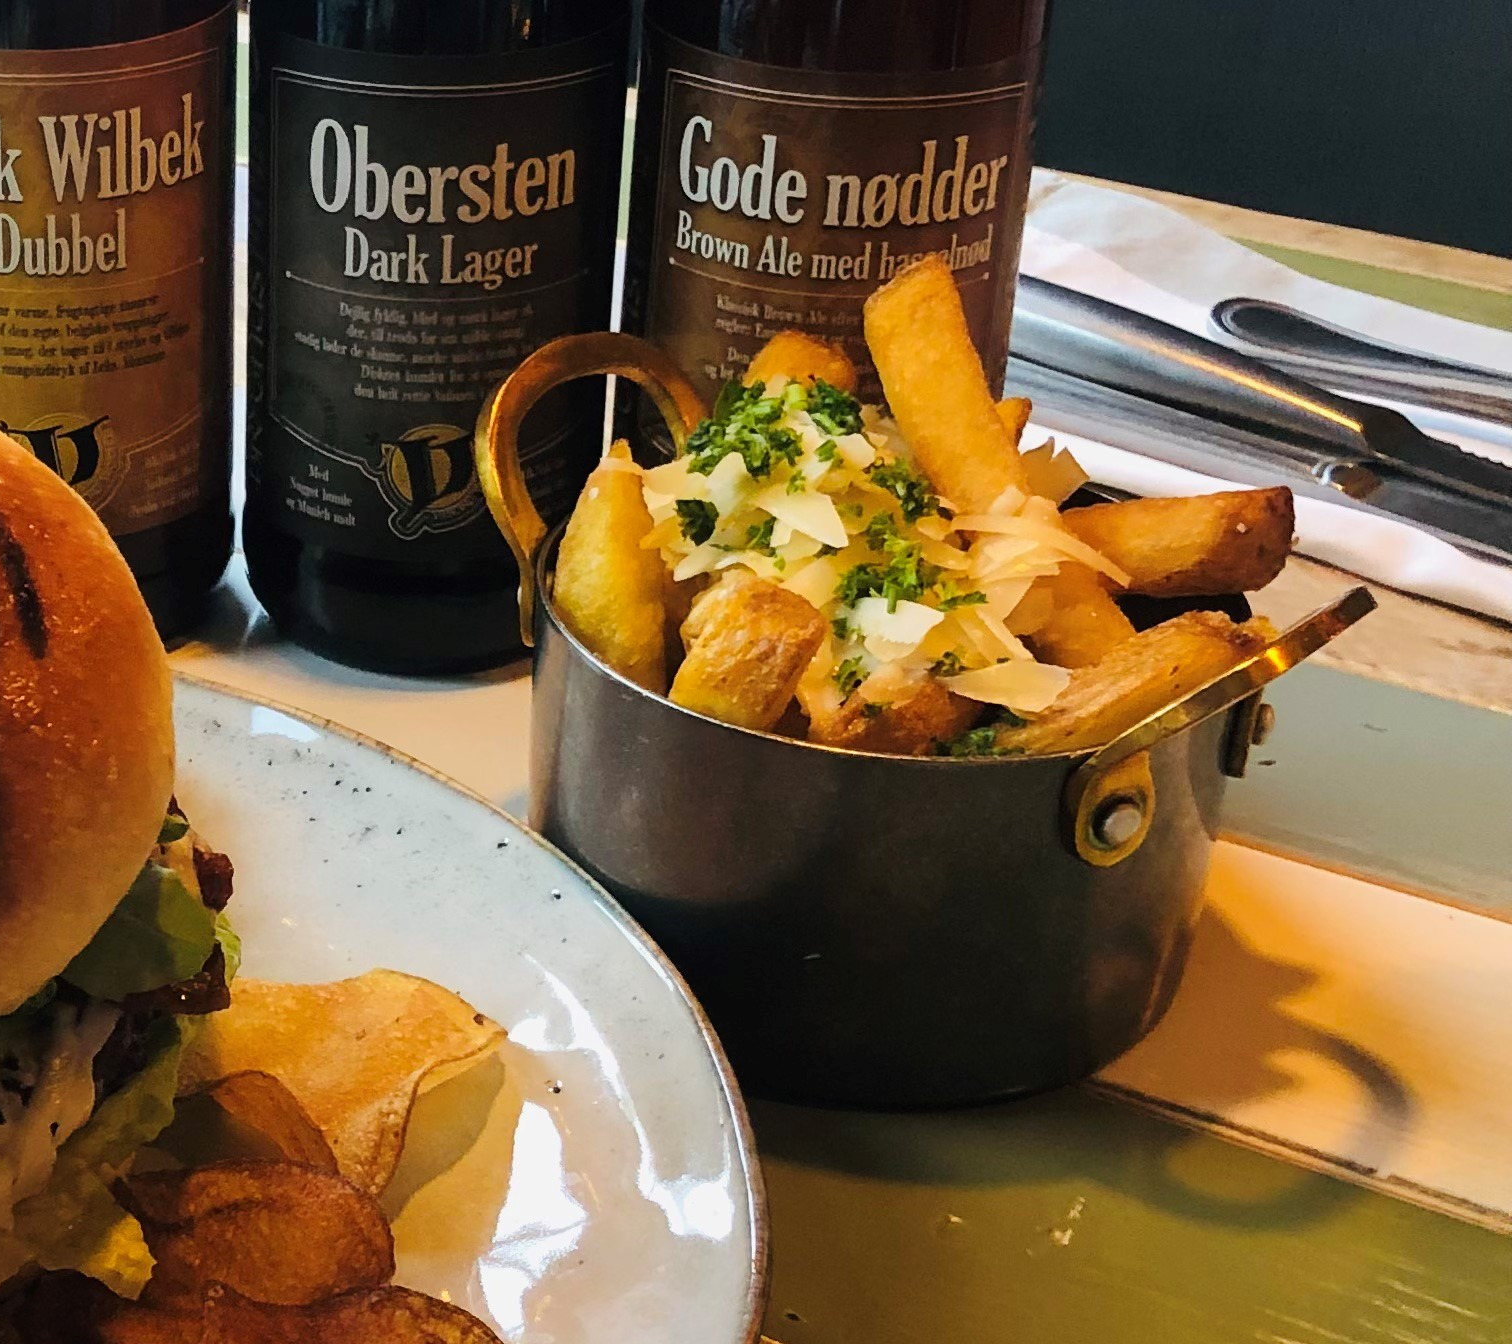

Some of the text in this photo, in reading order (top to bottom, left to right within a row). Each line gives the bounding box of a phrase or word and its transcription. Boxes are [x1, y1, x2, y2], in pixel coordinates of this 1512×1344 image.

[38, 93, 206, 203] Wilbek
[308, 117, 577, 225] Obersten
[678, 114, 1008, 229] Gode nødder
[342, 225, 539, 291] Dark Lager
[675, 209, 750, 270] Brown
[756, 233, 803, 279] Ale
[810, 241, 872, 280] med
